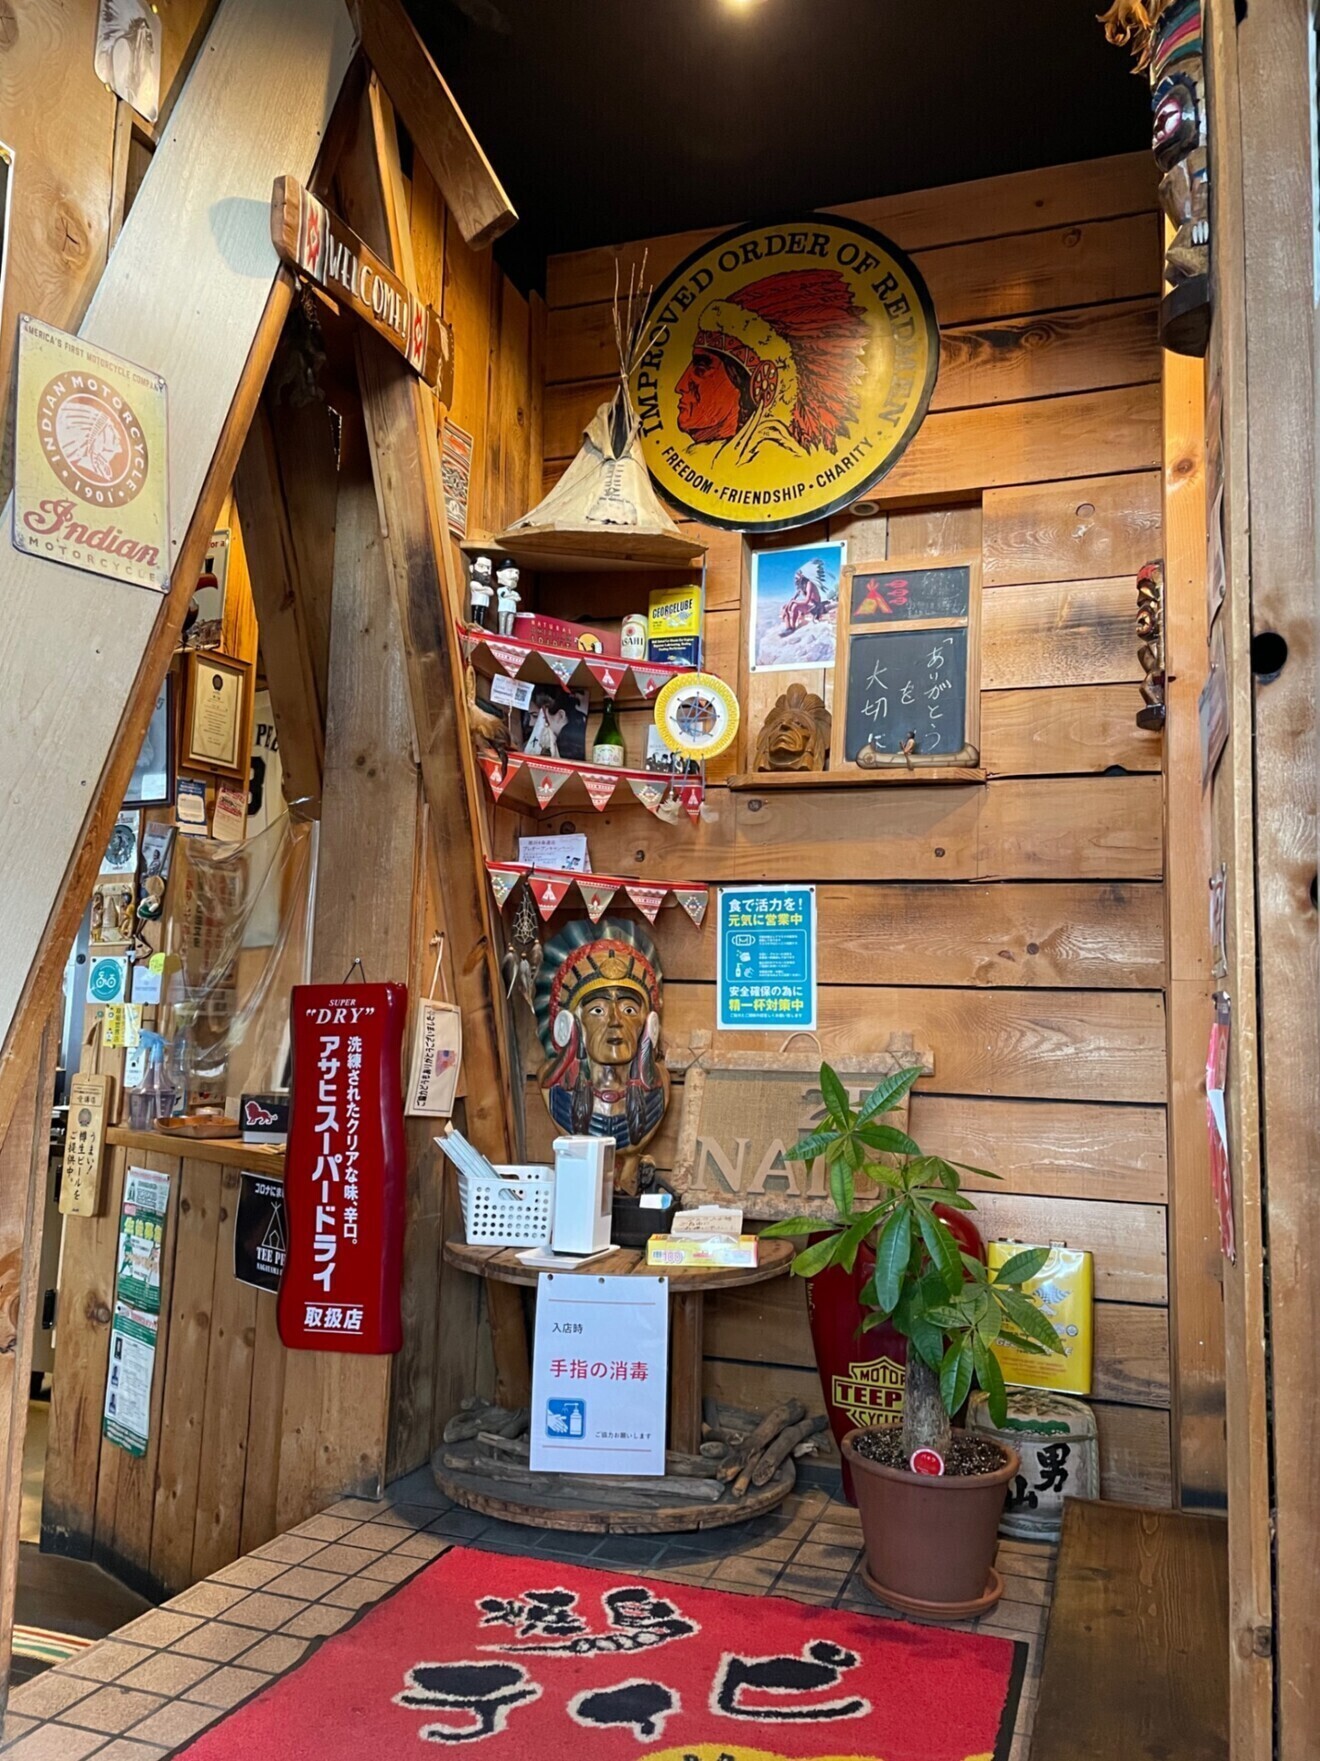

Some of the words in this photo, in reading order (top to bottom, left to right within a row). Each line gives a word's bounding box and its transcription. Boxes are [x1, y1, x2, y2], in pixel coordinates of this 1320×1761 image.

[329, 234, 408, 339] WELCOME!
[637, 267, 714, 437] IMPROVED
[718, 232, 831, 273] ORDER
[836, 243, 880, 275] OF
[24, 325, 63, 349] AMERICA'S
[64, 341, 84, 360] FIRST
[86, 351, 131, 380] MOTORCYCLE
[132, 373, 165, 394] COMPANY
[40, 380, 66, 462] INDIAN
[71, 375, 146, 492] MOTORCYCLE
[661, 445, 713, 495] FREEDOM
[719, 482, 806, 505] FRIENDSHIP
[815, 437, 874, 488] CHARITY
[75, 480, 114, 503] 1901
[24, 499, 160, 568] Indian
[29, 535, 157, 583] MOTORCYCLE
[652, 598, 694, 620] GEORGELUBE
[861, 659, 888, 749] 大切に
[900, 680, 916, 705] を
[728, 898, 803, 913] 食で活力を！
[728, 913, 803, 927] 元気に営業中
[329, 999, 357, 1007] SUPER
[729, 985, 803, 997] 安全確保の為に
[729, 998, 804, 1012] 精一杯対策中
[343, 1035, 362, 1245] 洗練されたクリアな味、辛口。
[311, 1035, 341, 1292] アサヒスーパードライ
[256, 1246, 273, 1263] TEE
[304, 1306, 363, 1330] 取扱店
[551, 1322, 584, 1335] 入店時
[550, 1359, 649, 1382] 手指の消毒
